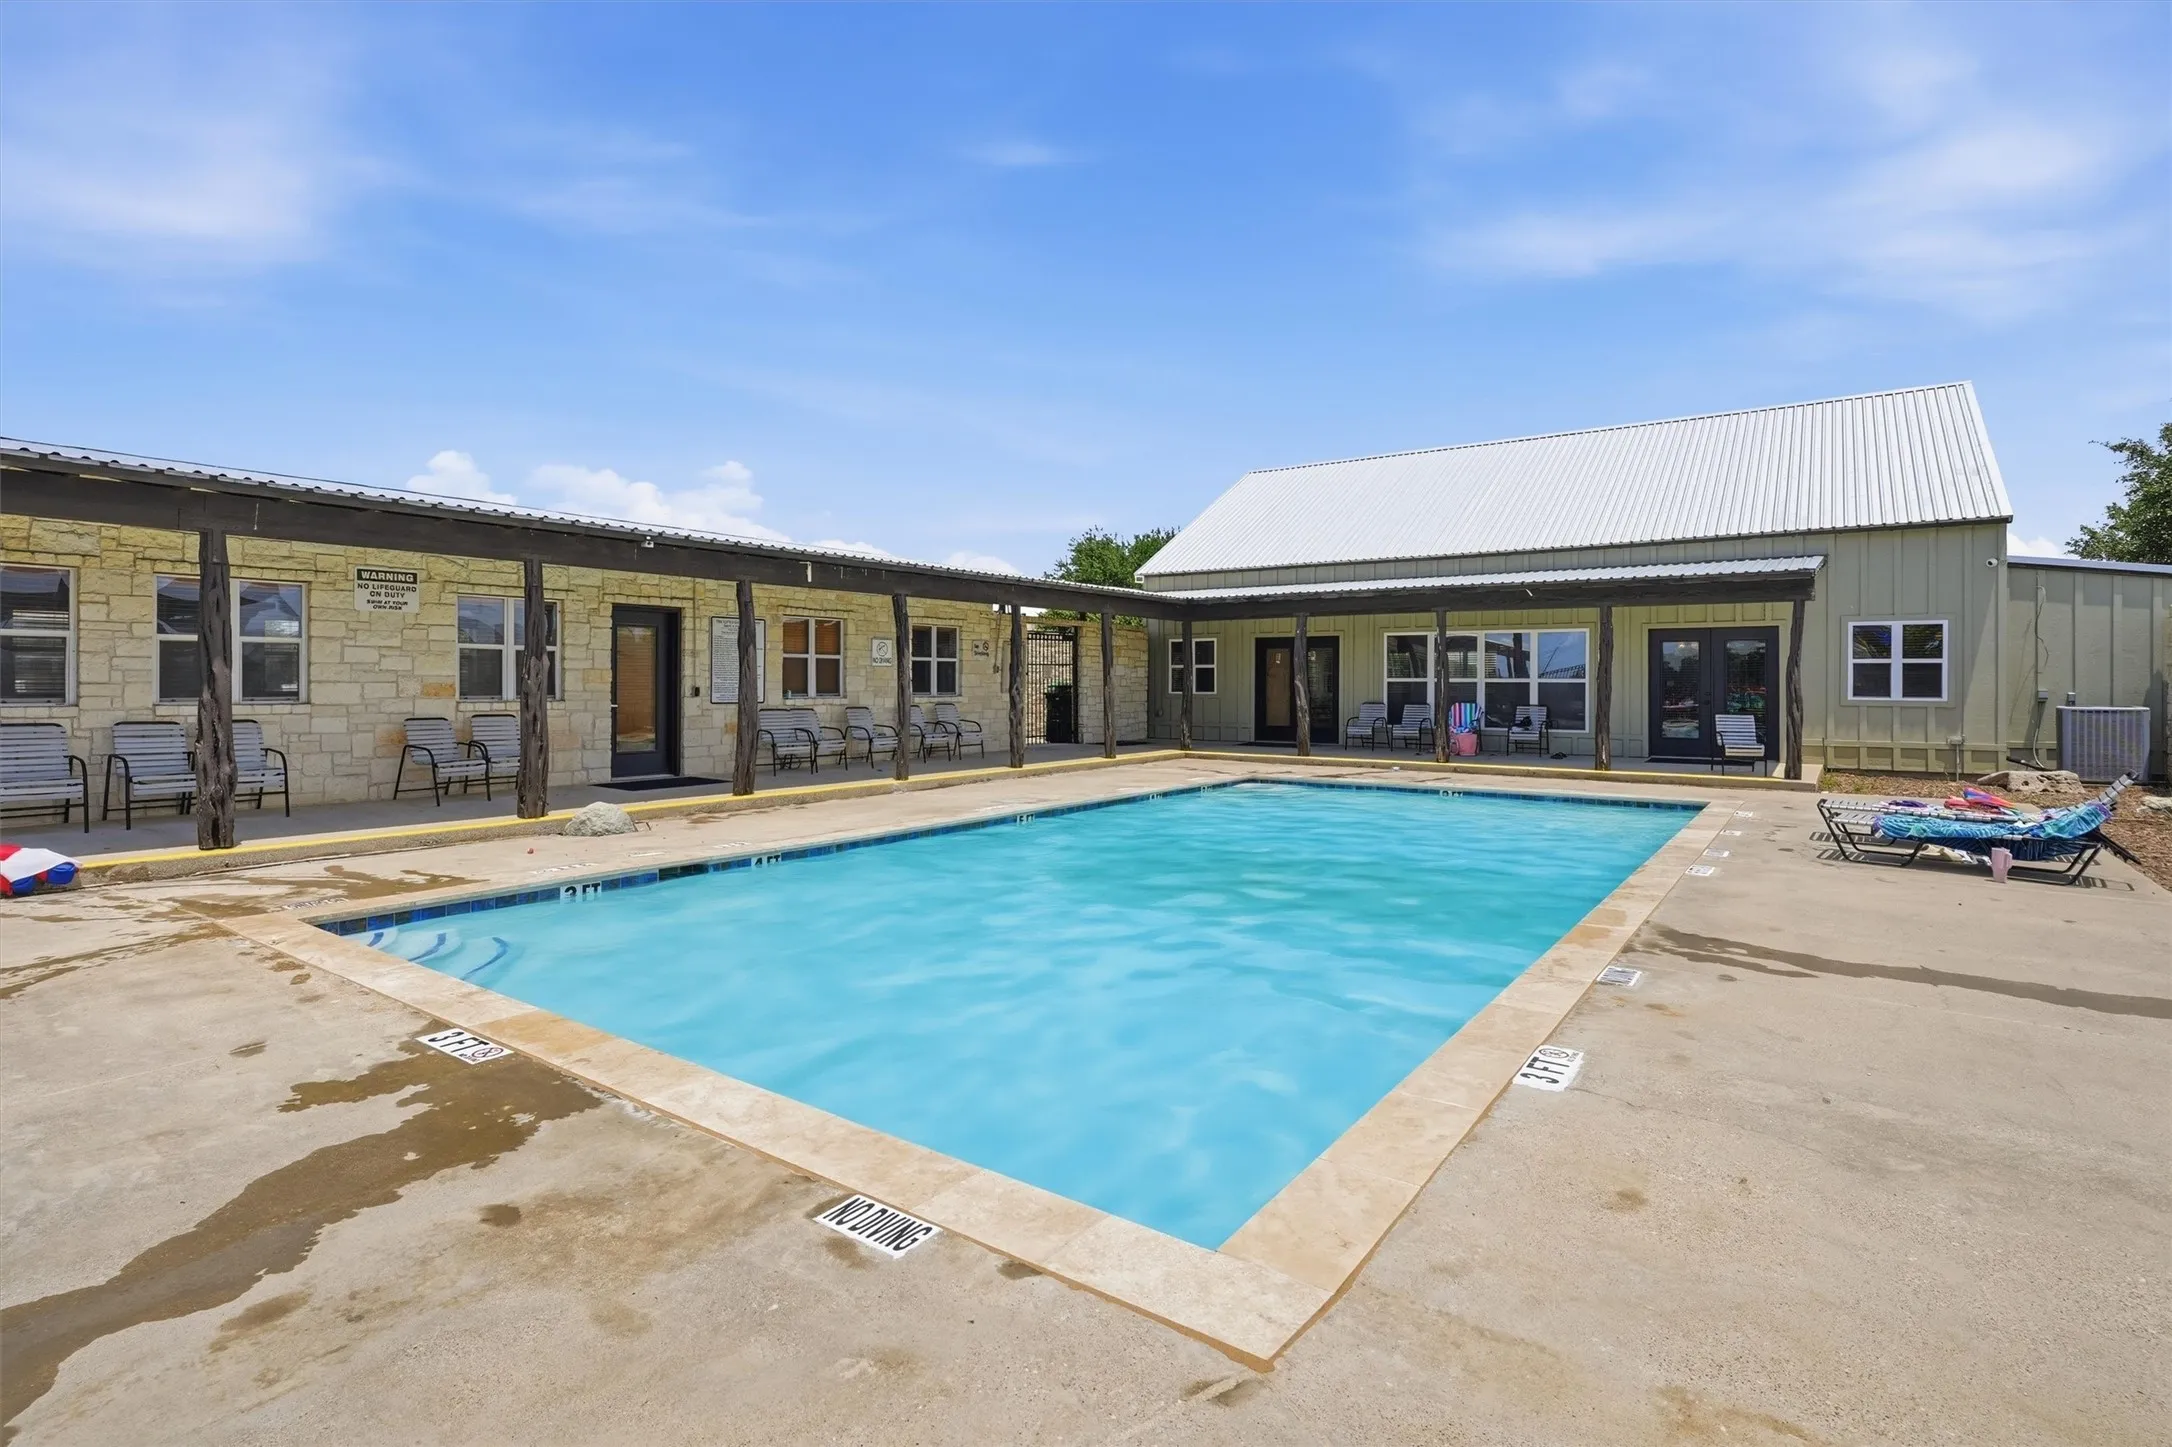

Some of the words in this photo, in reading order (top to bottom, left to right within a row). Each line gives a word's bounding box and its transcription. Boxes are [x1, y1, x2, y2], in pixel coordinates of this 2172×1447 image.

[361, 571, 413, 581] WARNING
[372, 584, 416, 592] LIFEGUARD
[428, 1032, 464, 1042] 3
[439, 1036, 490, 1054] FT
[1525, 1056, 1571, 1076] FT
[1519, 1072, 1560, 1084] 3
[823, 1197, 875, 1225] NO
[848, 1208, 933, 1251] DIVING
